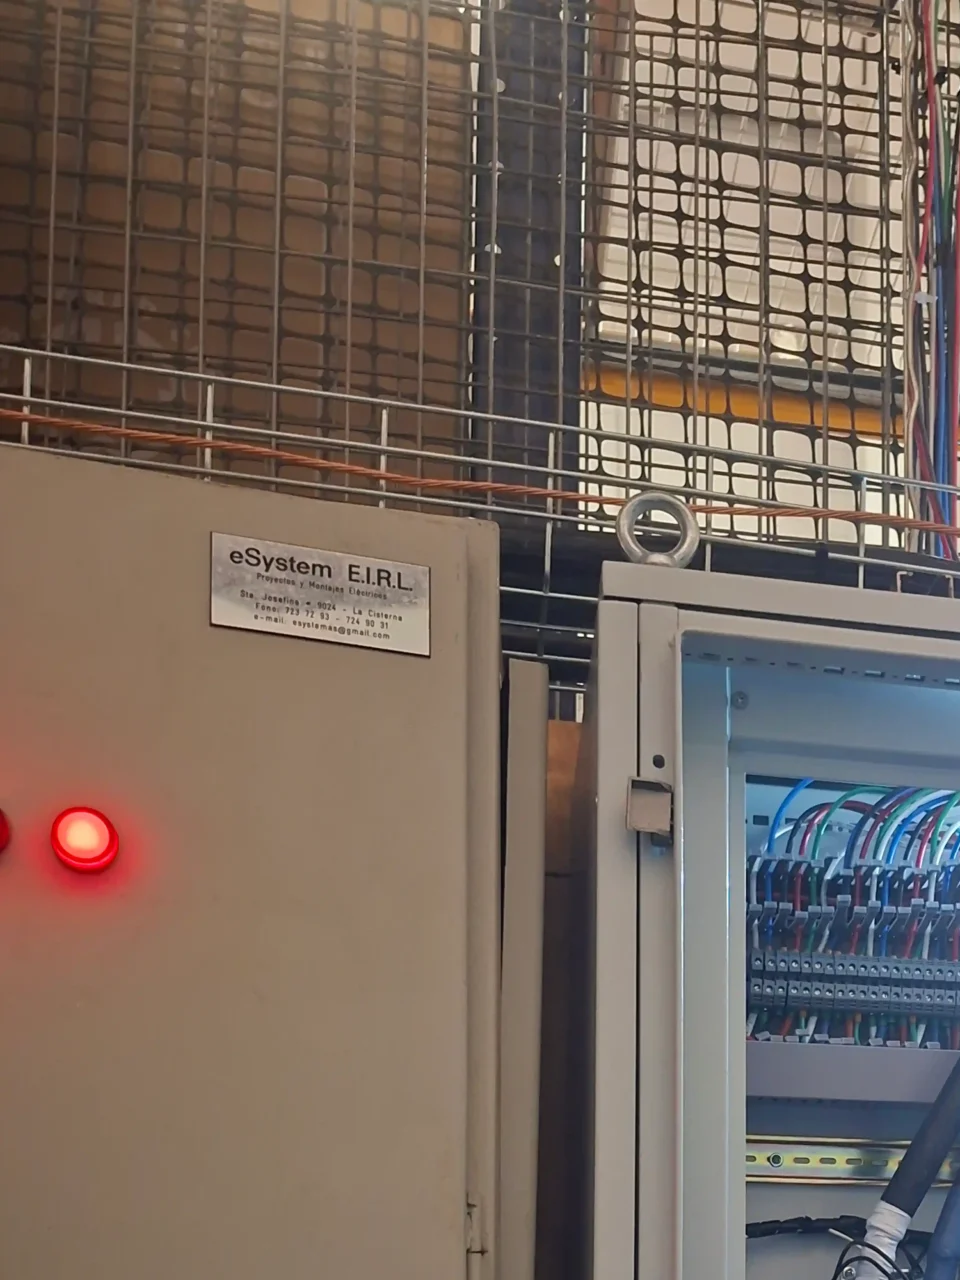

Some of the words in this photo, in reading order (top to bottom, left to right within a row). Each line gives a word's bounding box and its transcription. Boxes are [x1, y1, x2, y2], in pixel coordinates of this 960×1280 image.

[230, 547, 332, 578] eSystem
[348, 564, 413, 592] E.I.R.L.
[256, 573, 296, 586] Proyectos
[309, 582, 344, 594] Montajes
[285, 606, 300, 616] 723
[305, 609, 315, 618] 72
[320, 612, 330, 620] 93
[346, 615, 361, 626] 724
[380, 620, 389, 629] 31
[317, 601, 337, 611] 9024
[353, 606, 363, 616] La
[368, 609, 403, 622] Cisterna
